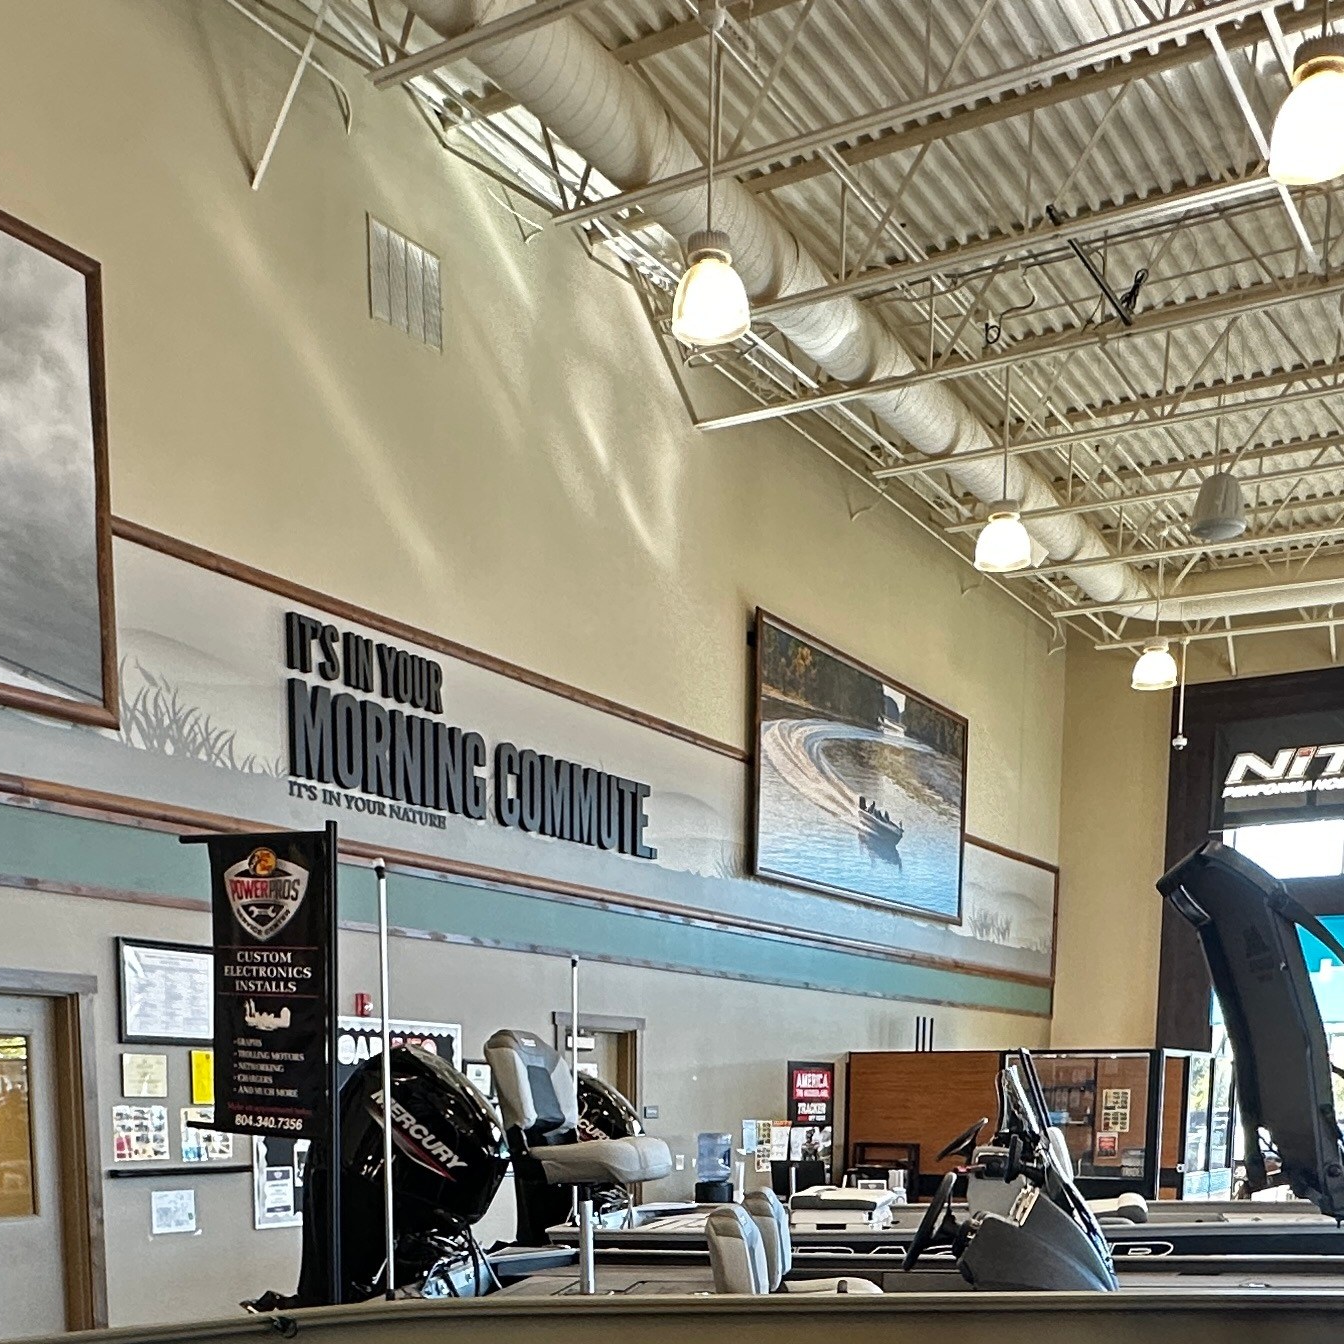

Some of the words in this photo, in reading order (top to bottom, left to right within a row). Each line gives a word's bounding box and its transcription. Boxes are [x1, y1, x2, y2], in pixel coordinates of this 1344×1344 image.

[286, 611, 340, 681] IT'S
[342, 631, 374, 693] IN
[375, 642, 443, 714] YOUR
[287, 677, 487, 820] MORNING
[494, 742, 658, 860] COMMUTE.
[288, 780, 318, 801] IT'S
[322, 788, 342, 808] IN
[344, 793, 386, 817] YOUR
[389, 802, 447, 830] NATURE
[236, 950, 293, 964] CUSTOM
[223, 964, 313, 979] ELECTRONICS
[235, 980, 298, 993] INSTALLS
[235, 1113, 304, 1130] 804.340.7356
